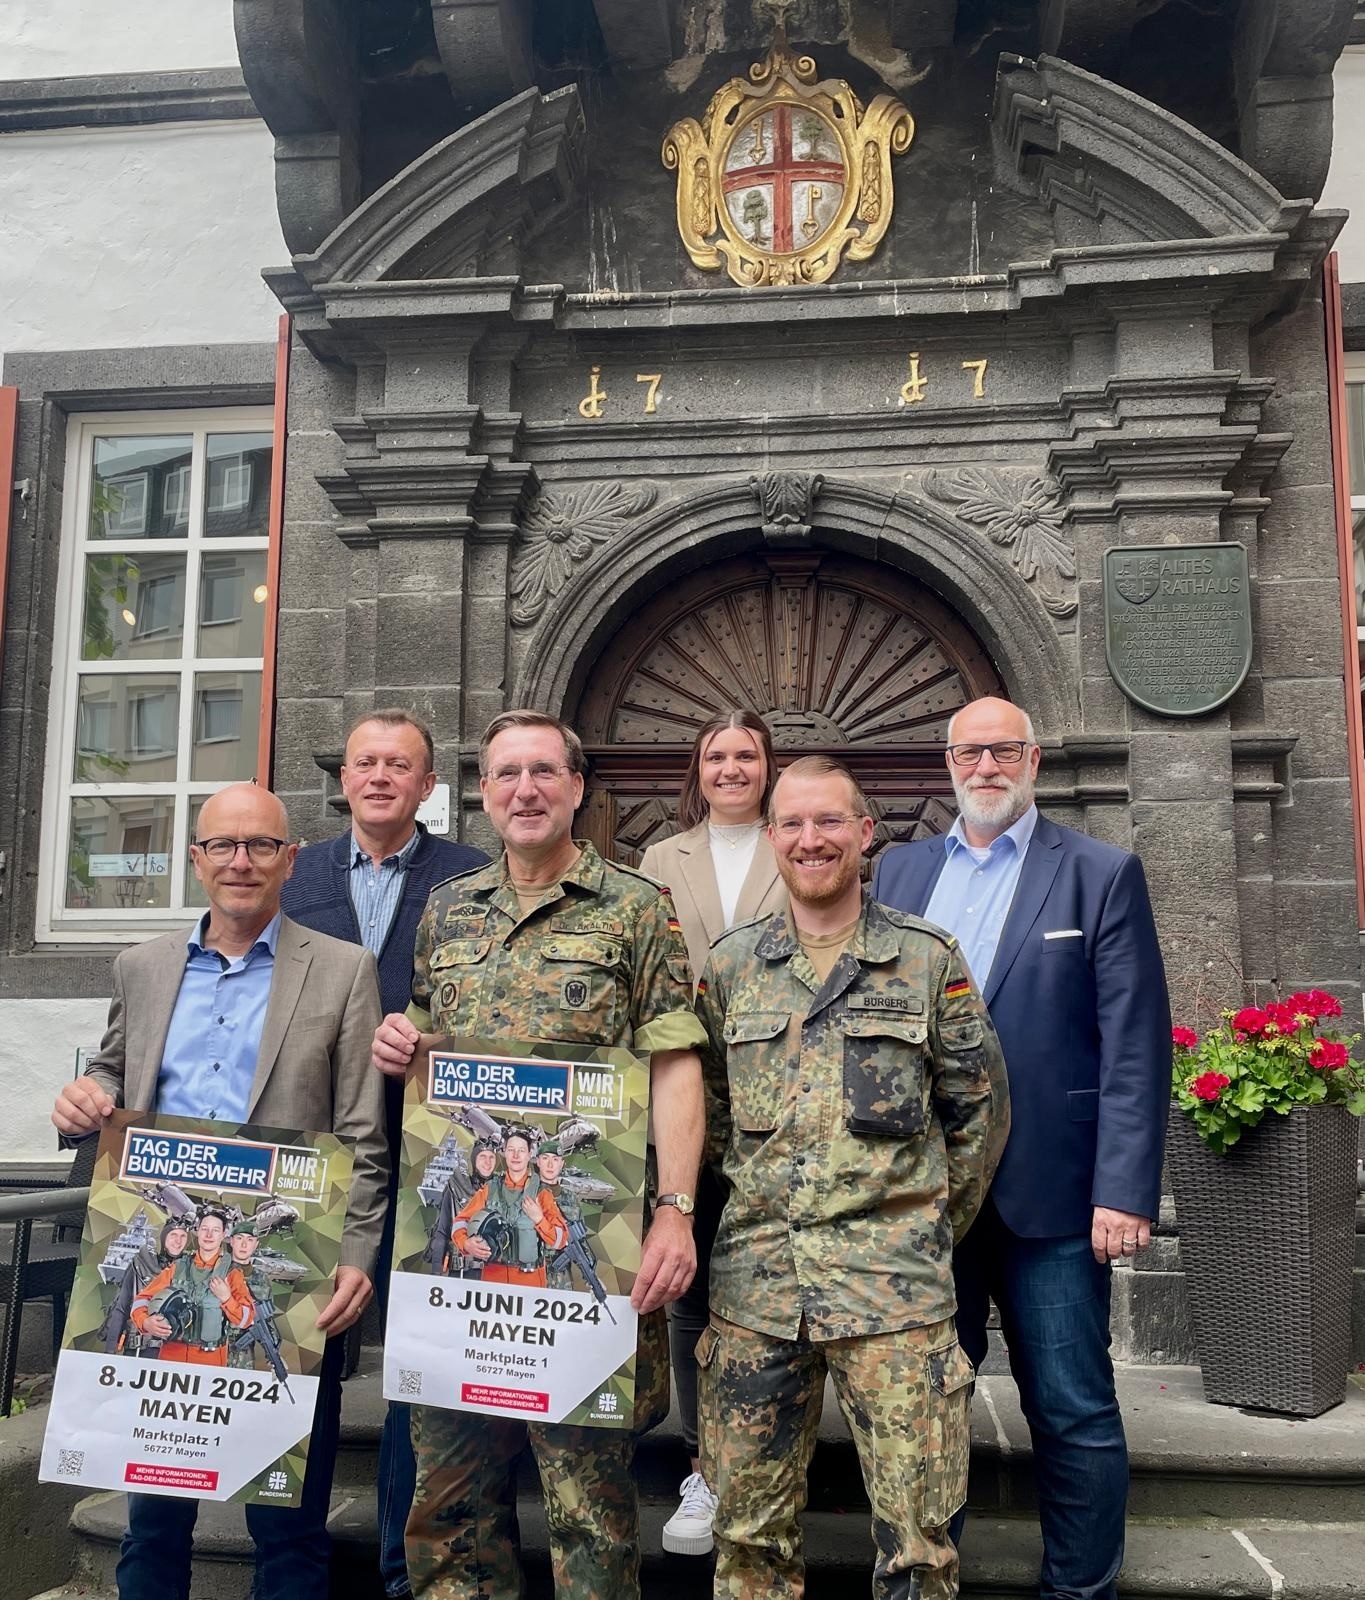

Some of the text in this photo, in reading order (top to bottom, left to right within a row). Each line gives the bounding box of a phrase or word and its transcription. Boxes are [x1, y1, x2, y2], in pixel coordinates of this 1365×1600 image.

[1161, 558, 1214, 576] ALTES
[1160, 577, 1241, 595] RATHAUS
[423, 818, 444, 827] amt
[435, 1061, 515, 1083] TAG DER
[434, 1078, 564, 1105] BUNDESWEHR
[578, 1072, 614, 1095] WIR
[576, 1095, 613, 1109] SIND DA
[132, 1137, 217, 1162] TAG DER
[127, 1155, 266, 1186] BUNDESWEHR
[281, 1154, 317, 1178] WIR
[277, 1177, 315, 1192] SIND DA
[429, 1286, 601, 1325] 8. JUNI 2024
[469, 1319, 555, 1347] MAYEN
[465, 1348, 548, 1368] Marktplatz 1
[476, 1365, 536, 1380] 56727 Mayen
[99, 1365, 280, 1404] 8. JUNI 2024
[466, 1394, 544, 1410] TAG-DER-BUNDESWEHR.DE
[471, 1387, 539, 1402] MEHR INFORMATIONEN:
[139, 1398, 232, 1425] MAYEN
[132, 1427, 221, 1447] Marktplatz 1
[144, 1444, 206, 1459] 56727 Mayen
[129, 1473, 213, 1488] TAG-DER-BUNDESWEHR.DE
[136, 1466, 208, 1480] MEHR INFORMATIONEN:
[258, 1490, 293, 1499] BUNDESWEHR
